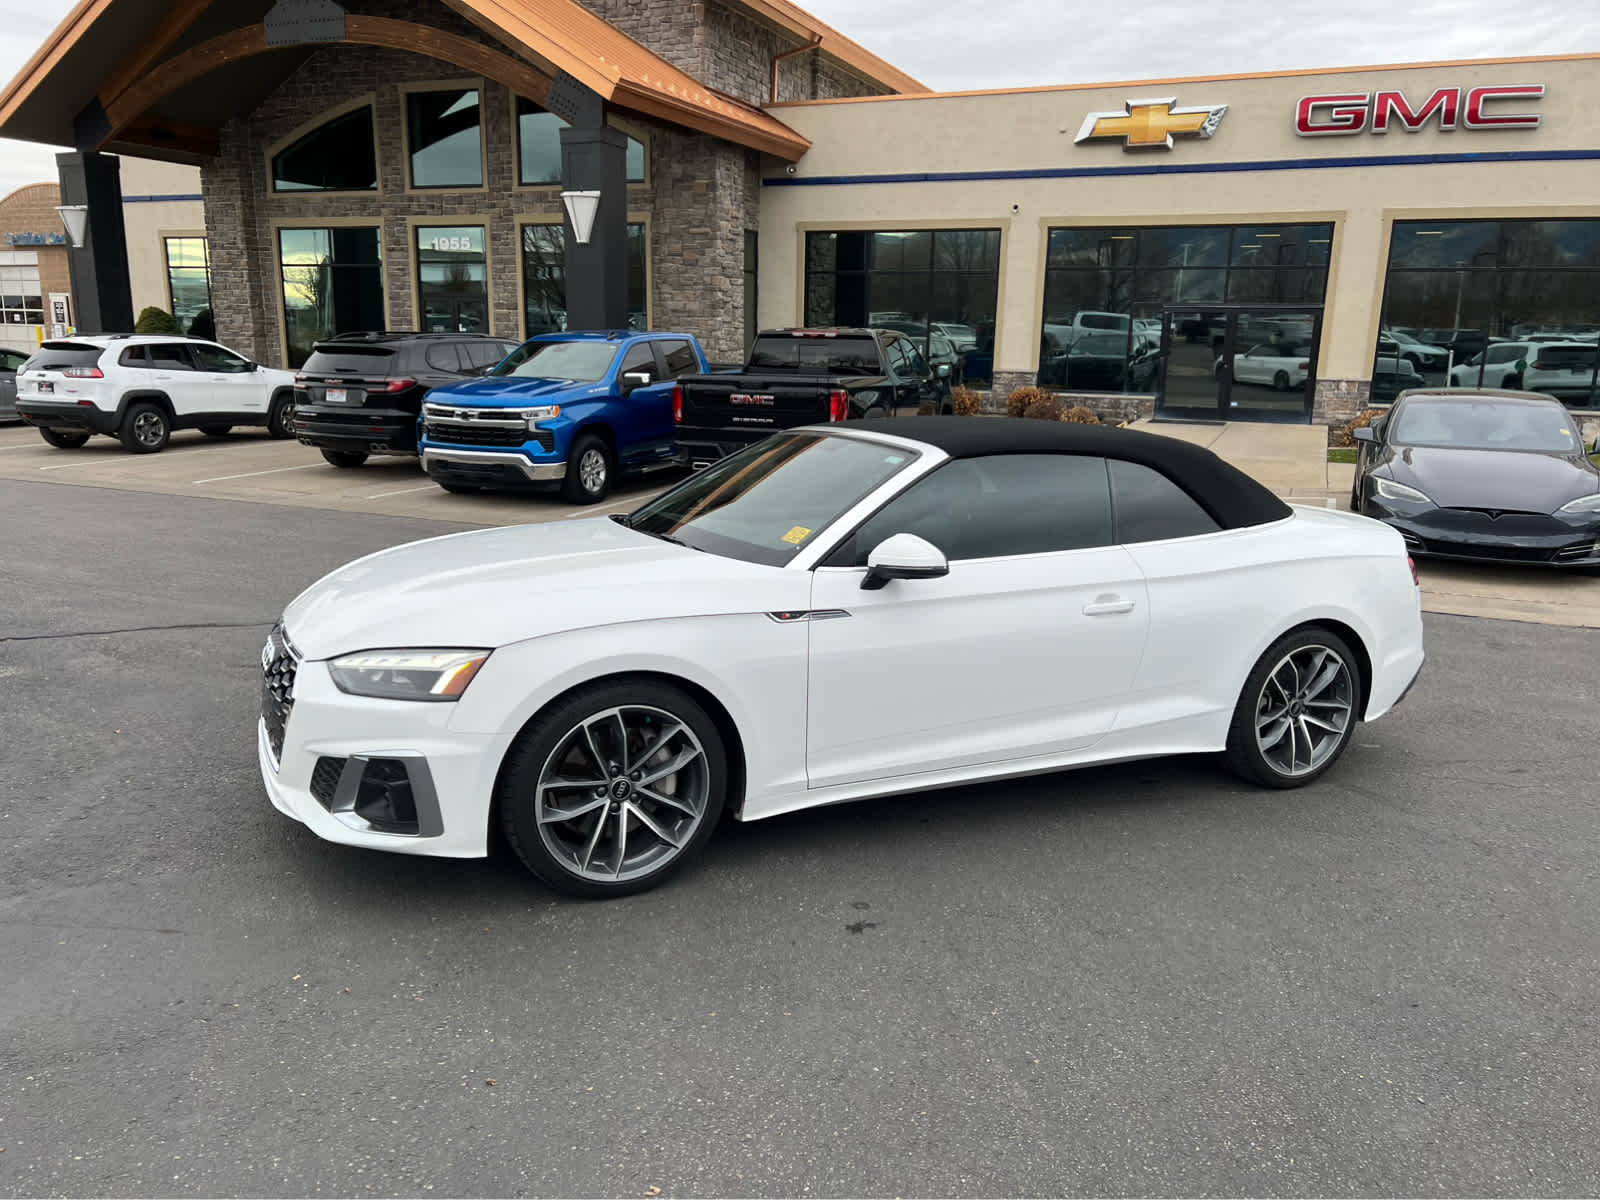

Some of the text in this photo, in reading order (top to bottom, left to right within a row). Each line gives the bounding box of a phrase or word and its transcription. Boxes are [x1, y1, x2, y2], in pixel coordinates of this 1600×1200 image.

[1296, 84, 1546, 137] GMC
[432, 237, 471, 251] 1955
[730, 394, 774, 406] GMC
